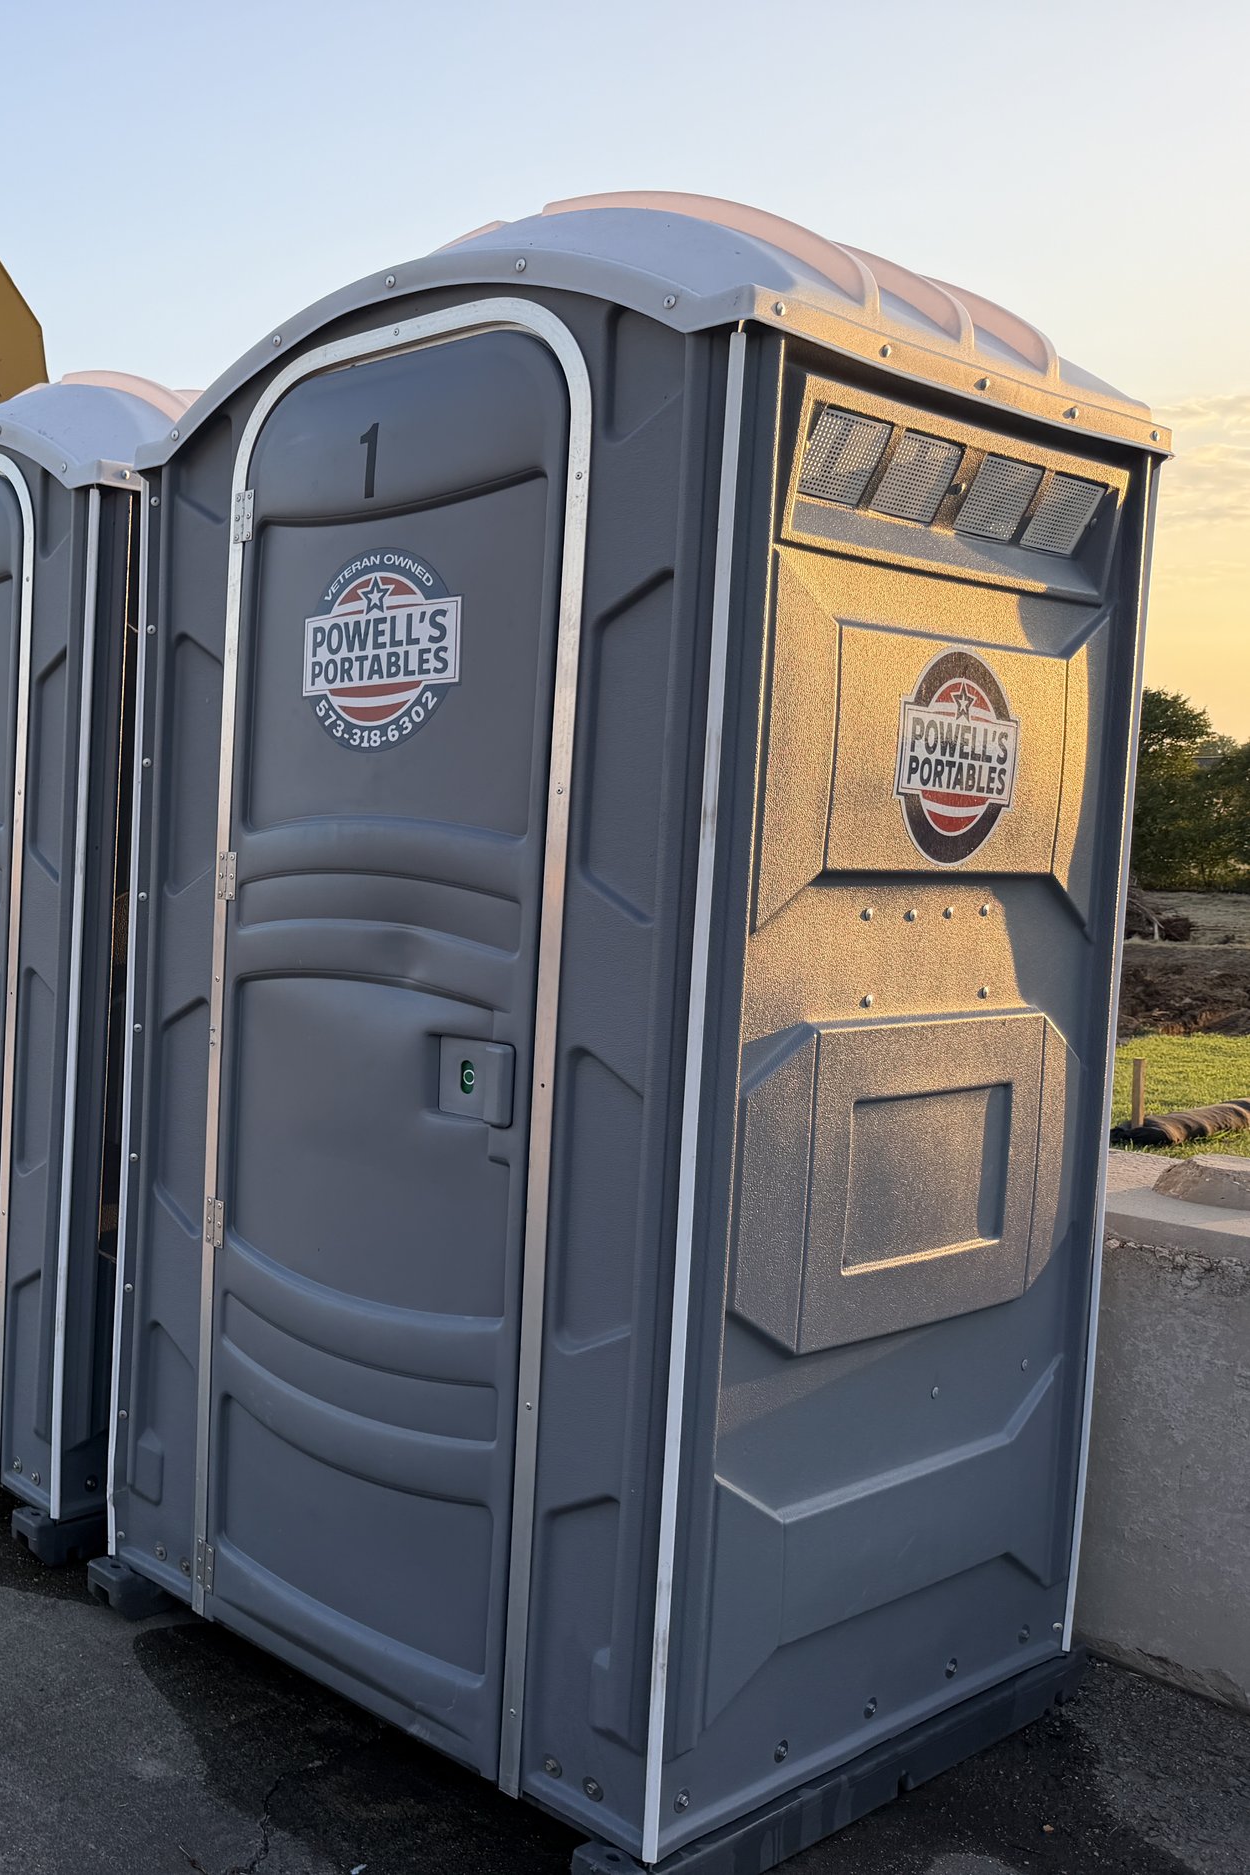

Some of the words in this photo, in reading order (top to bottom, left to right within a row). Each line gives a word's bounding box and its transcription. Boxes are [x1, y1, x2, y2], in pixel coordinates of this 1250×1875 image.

[360, 422, 380, 499] 1
[324, 554, 381, 601] VETERAN
[383, 553, 435, 588] OWNED
[311, 607, 448, 658] POWELL'S
[310, 646, 449, 686] PORTABLES
[316, 691, 438, 748] 573-318-6302
[910, 716, 1009, 766] POWELL'S
[906, 755, 1008, 796] PORTABLES
